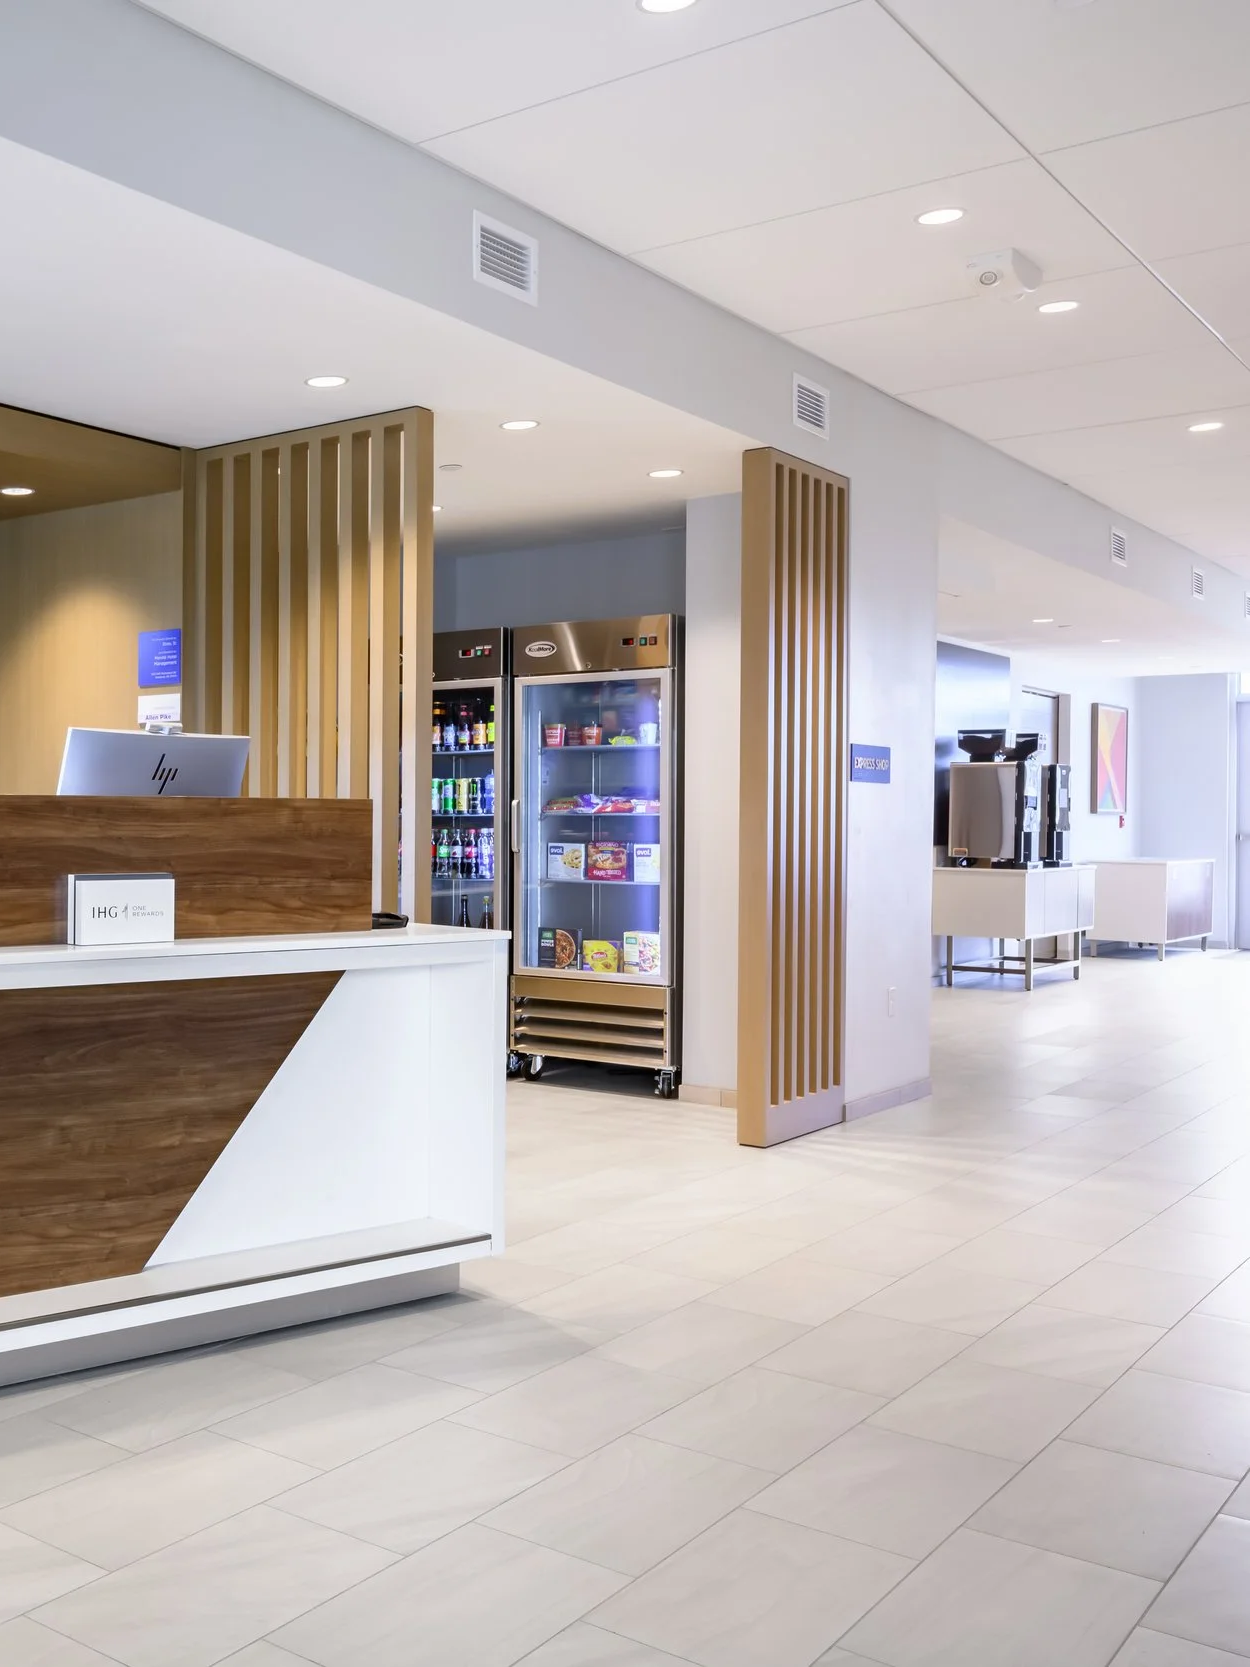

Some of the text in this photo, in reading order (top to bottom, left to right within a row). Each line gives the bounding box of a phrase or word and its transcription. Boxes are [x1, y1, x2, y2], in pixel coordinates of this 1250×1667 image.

[854, 757, 889, 771] EXPRESS SHOP
[151, 753, 178, 795] hp
[92, 906, 118, 918] IHG
